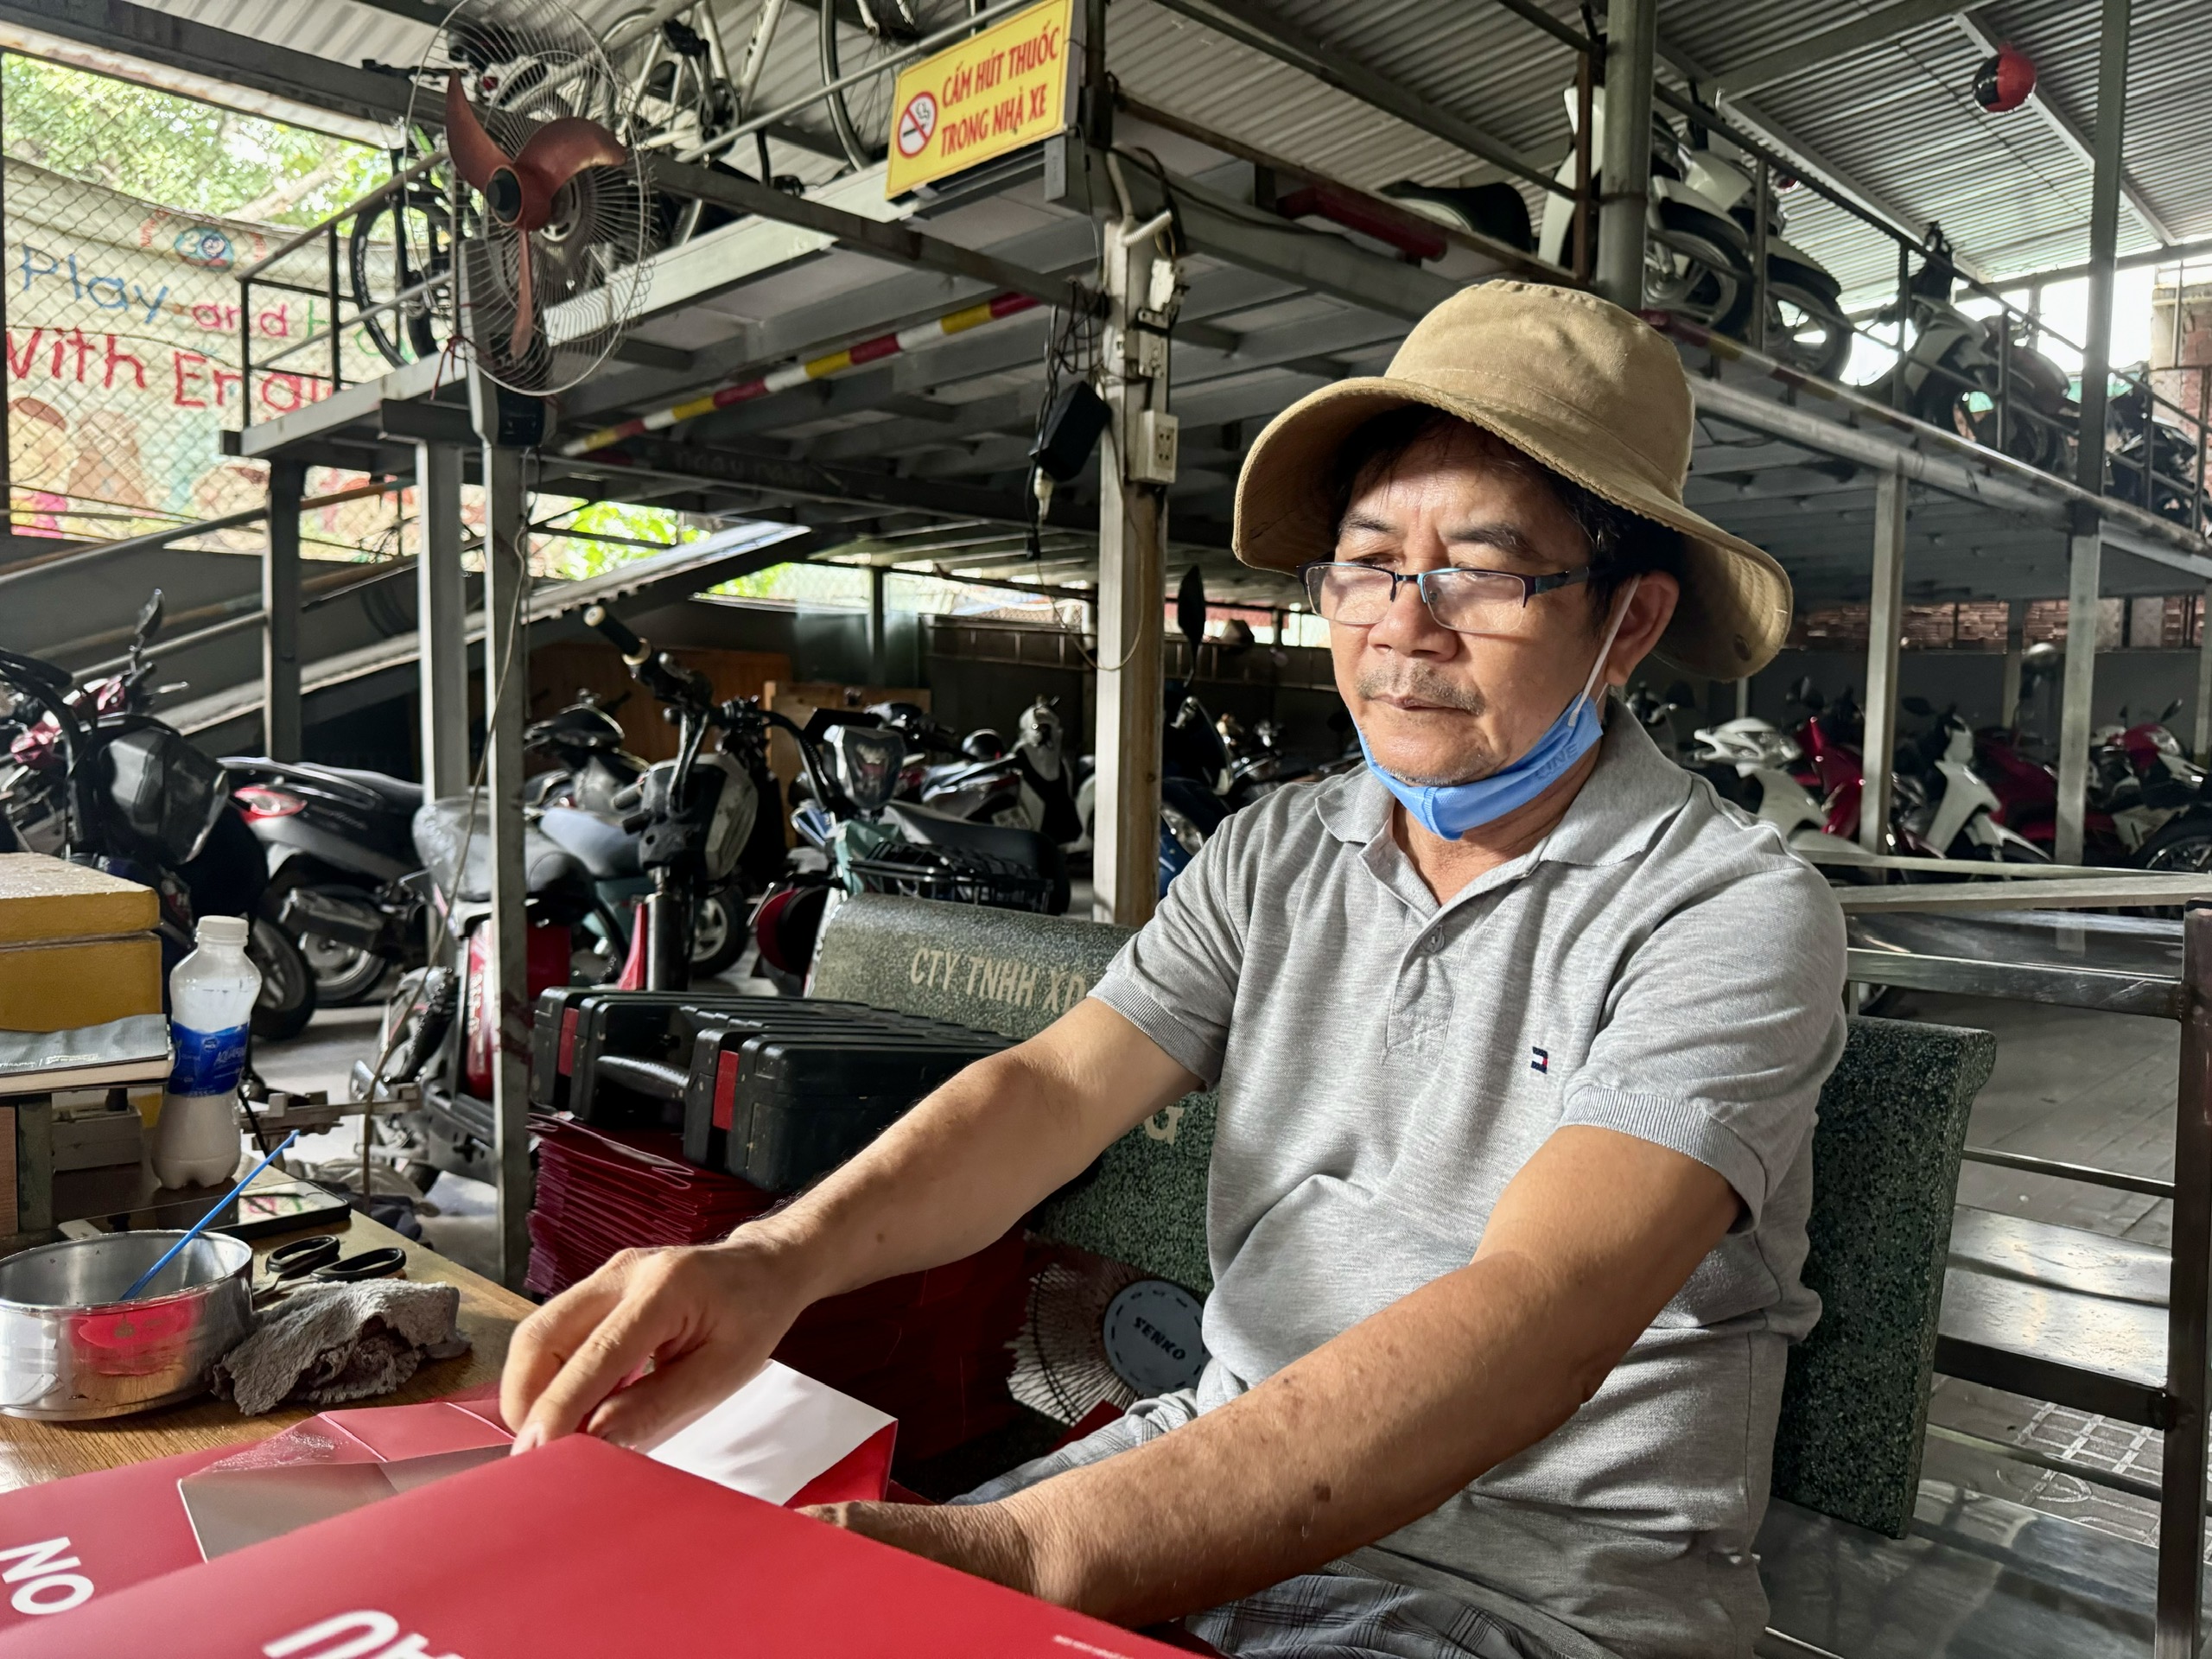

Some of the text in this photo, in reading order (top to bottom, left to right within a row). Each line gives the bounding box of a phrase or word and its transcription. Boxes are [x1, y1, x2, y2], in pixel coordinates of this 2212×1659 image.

[975, 49, 1005, 94] HÚT
[941, 84, 1047, 157] TRONG NHÀ XE
[19, 243, 168, 324] Play
[911, 948, 959, 990] CTY
[968, 957, 1038, 1007] TNHH
[1132, 1316, 1186, 1362] SENKO
